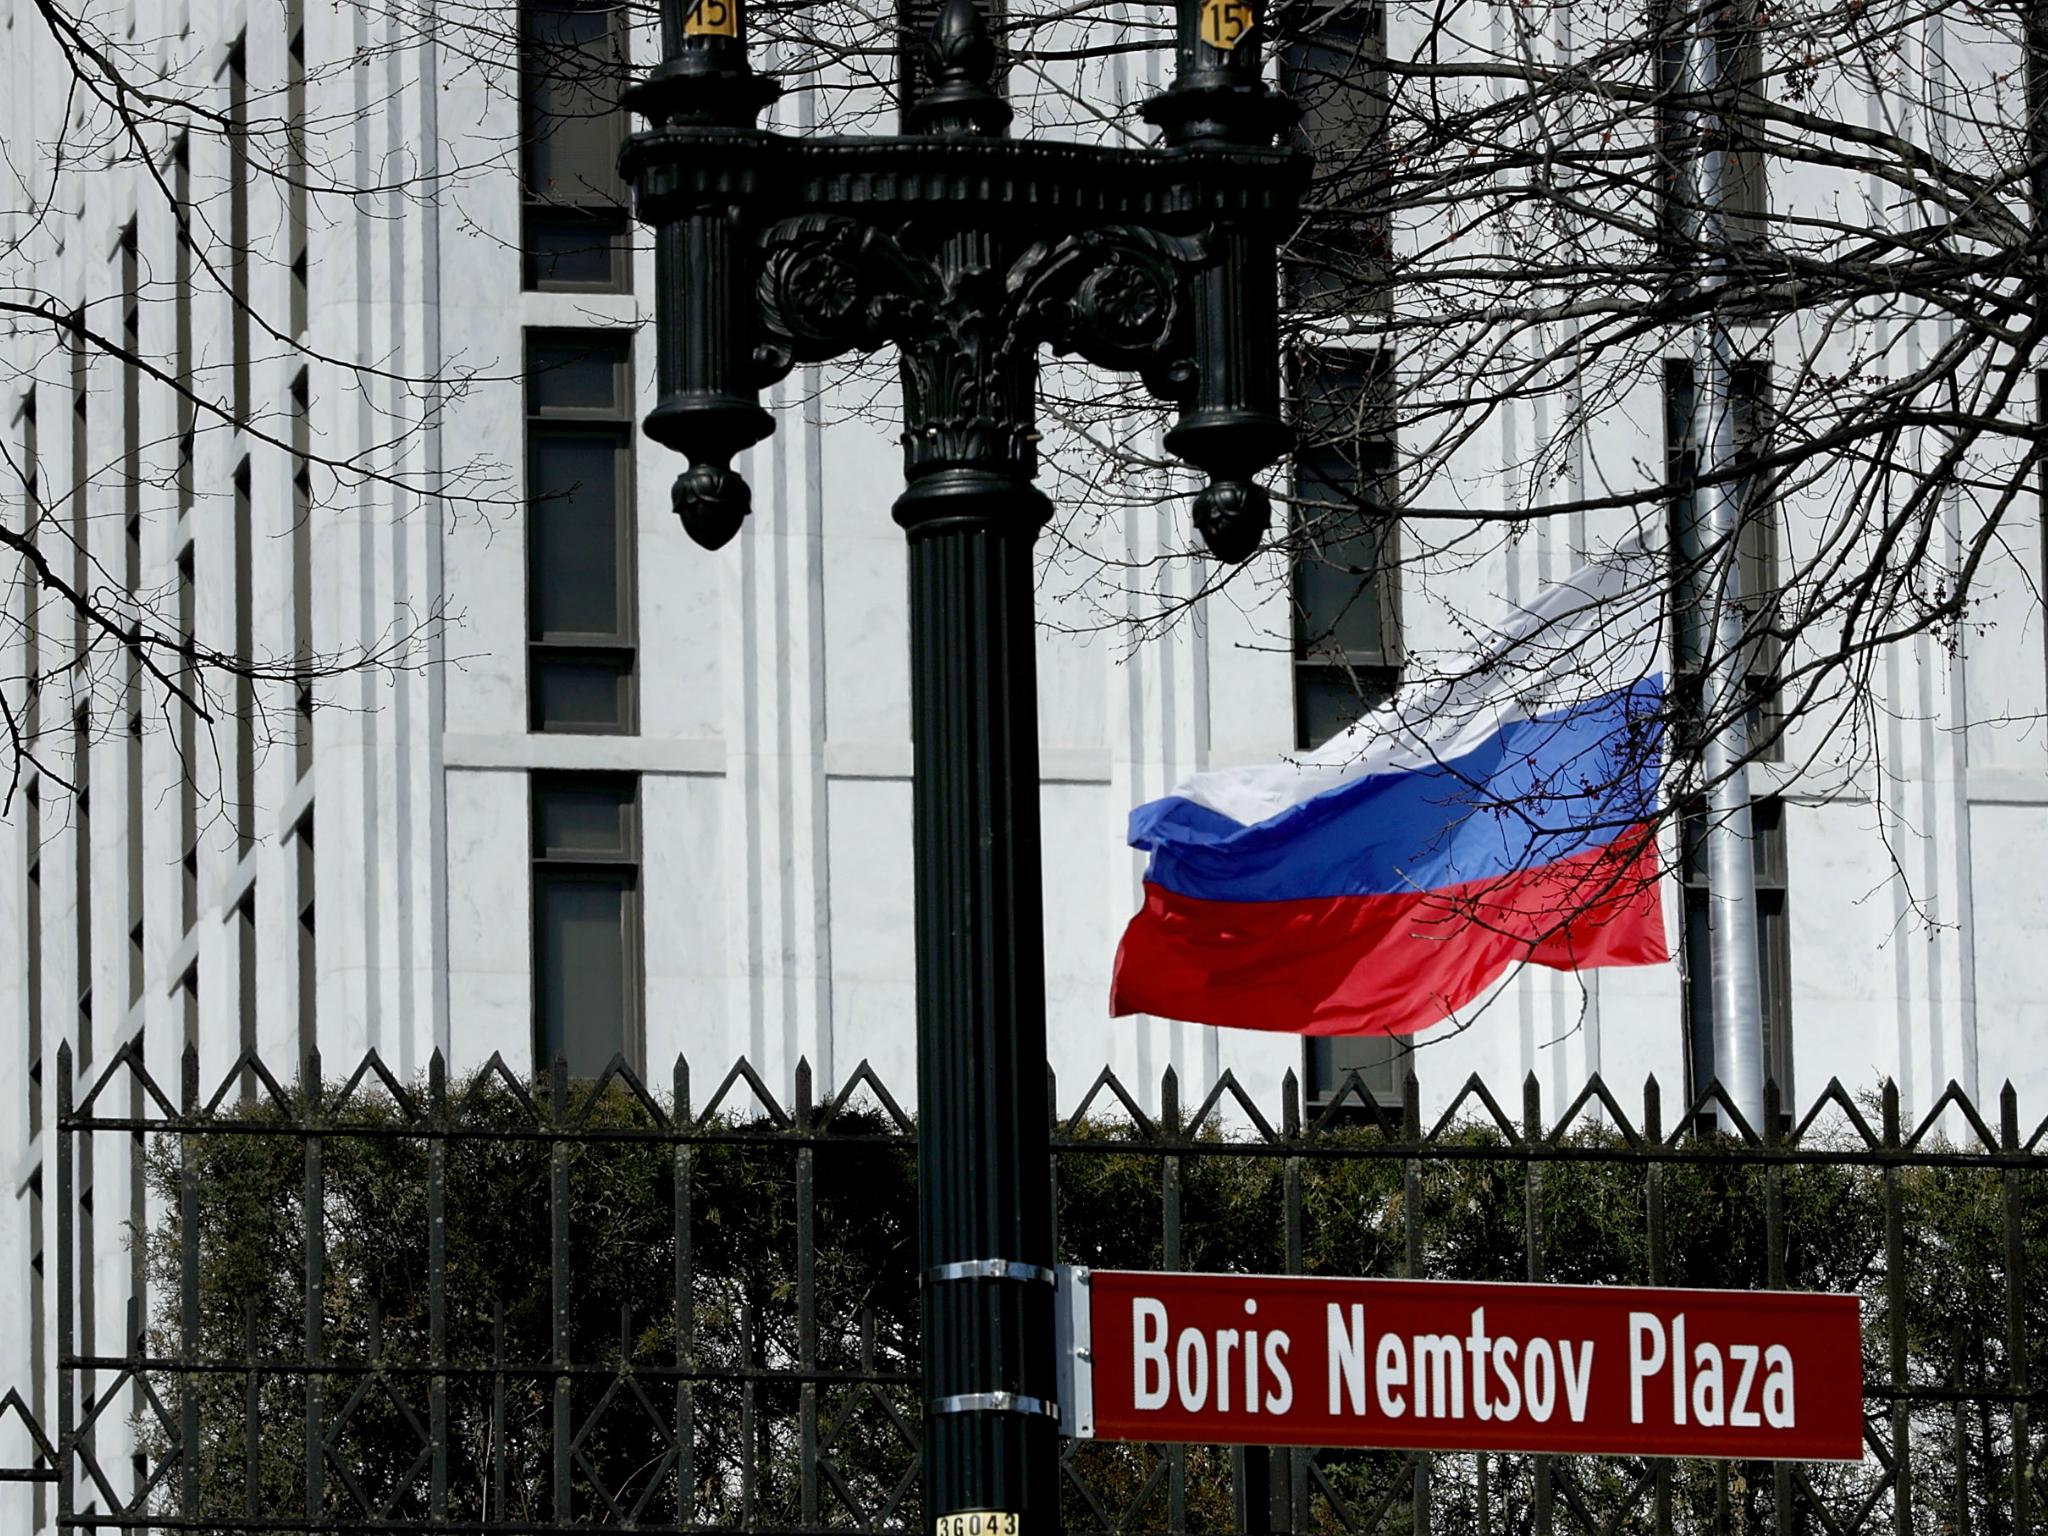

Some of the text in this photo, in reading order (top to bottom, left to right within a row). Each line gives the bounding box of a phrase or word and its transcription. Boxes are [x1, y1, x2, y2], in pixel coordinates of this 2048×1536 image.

[696, 0, 728, 26] 15
[1210, 3, 1244, 42] 15
[1132, 1297, 1795, 1429] Boris Nemtsov Plaza
